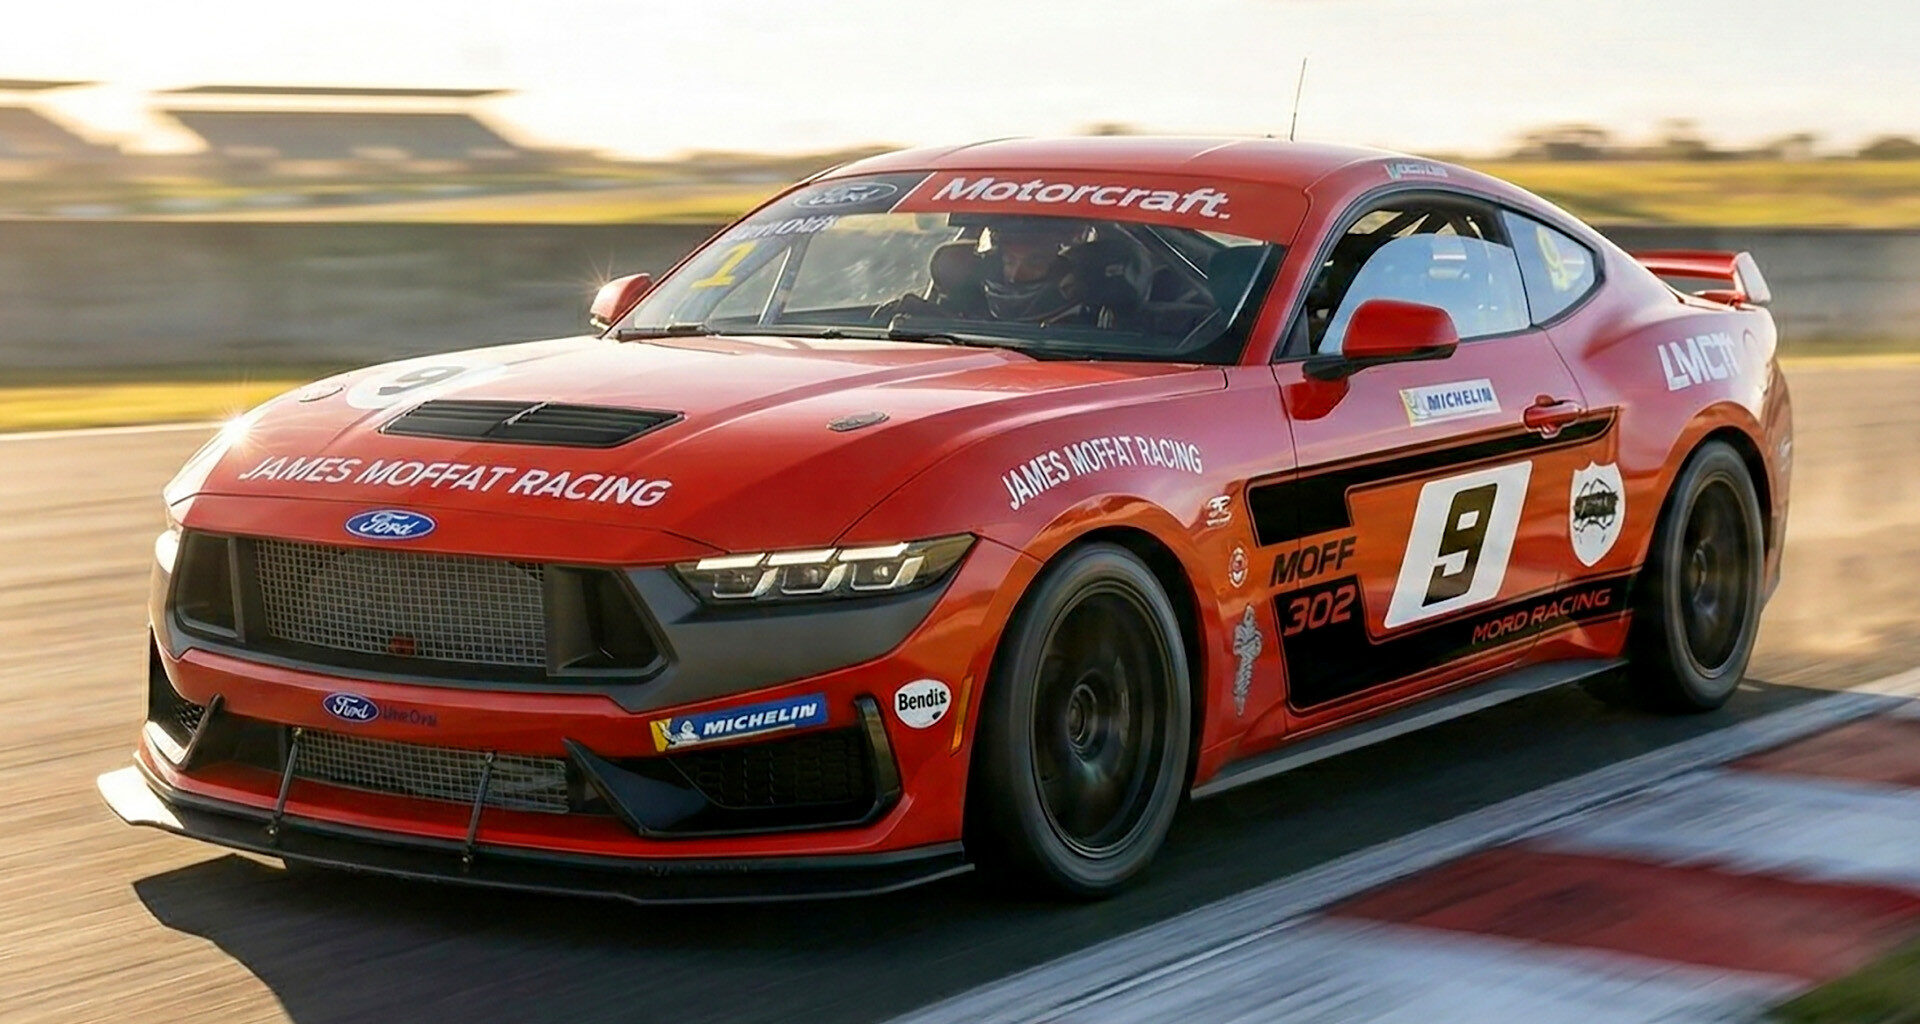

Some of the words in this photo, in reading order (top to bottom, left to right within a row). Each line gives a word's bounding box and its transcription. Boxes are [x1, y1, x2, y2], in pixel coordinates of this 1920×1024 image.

[932, 177, 1231, 219] Motorcraft.
[376, 366, 467, 396] 9
[1427, 387, 1493, 411] MICHELIN
[238, 456, 362, 483] JAMES
[354, 460, 517, 492] MOFFAT
[508, 469, 672, 507] RACING
[1002, 451, 1070, 511] JAMES
[1064, 436, 1141, 476] MOFFAT
[1135, 436, 1203, 475] RACING
[359, 512, 419, 536] Ford
[1422, 482, 1498, 608] 9
[1270, 536, 1357, 588] MOFF
[1283, 584, 1357, 637] 302
[1472, 611, 1527, 645] MORD
[1530, 588, 1611, 626] RACING
[703, 702, 818, 735] MICHELIN
